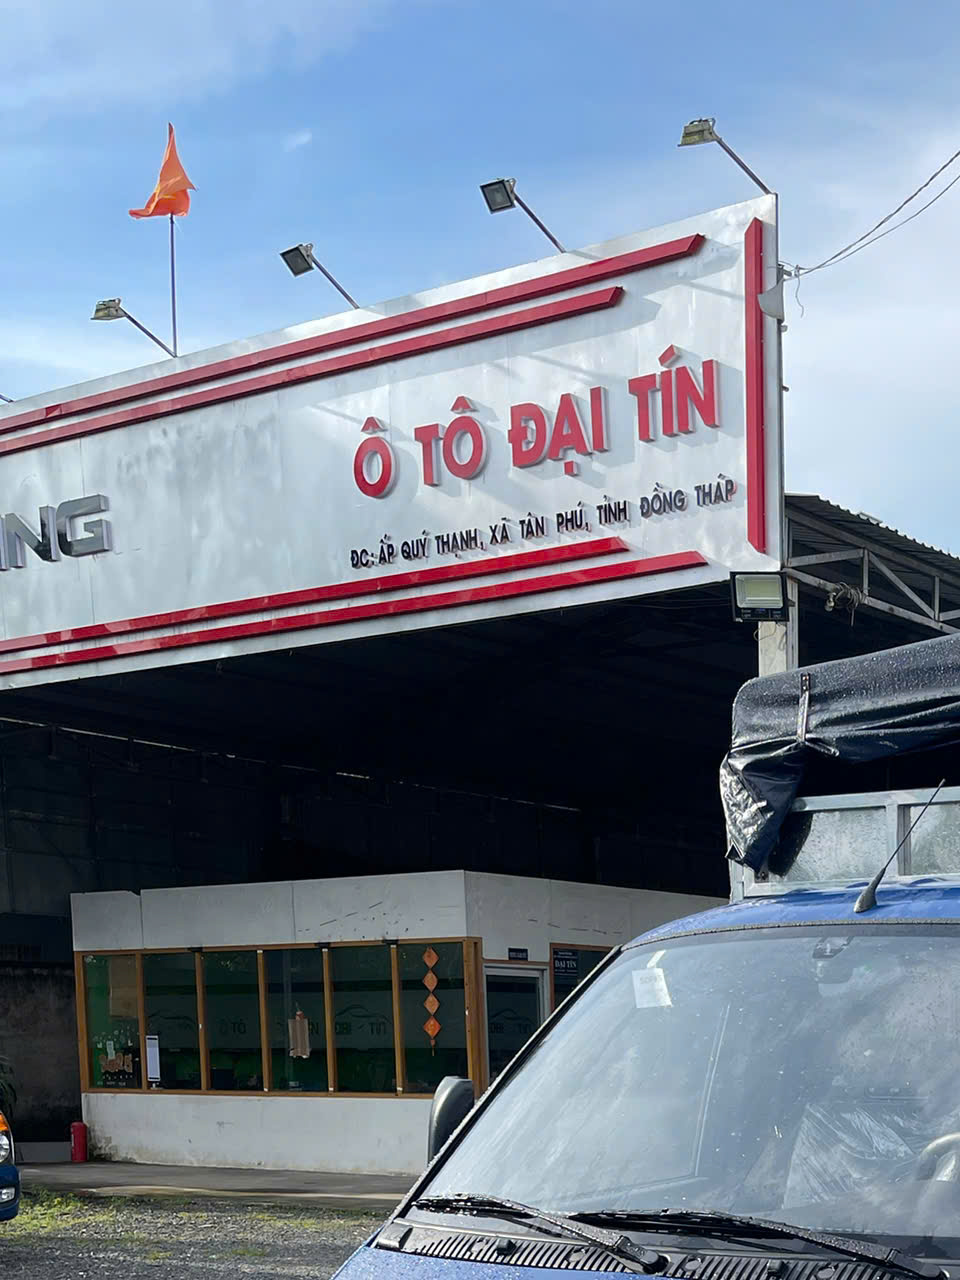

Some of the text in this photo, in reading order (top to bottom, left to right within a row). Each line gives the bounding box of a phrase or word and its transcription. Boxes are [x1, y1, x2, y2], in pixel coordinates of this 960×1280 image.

[353, 344, 721, 499] Ô TÔ ĐẠI TÍN
[0, 493, 112, 571] NG
[401, 530, 429, 560] QUÝ
[434, 528, 486, 558] THẠNH,
[489, 517, 512, 545] XÃ
[519, 512, 547, 539] TÂN
[556, 501, 591, 533] PHÚ,
[596, 495, 630, 525] TỈNH
[640, 482, 688, 519] ĐỒNG
[694, 473, 737, 507] THÁP
